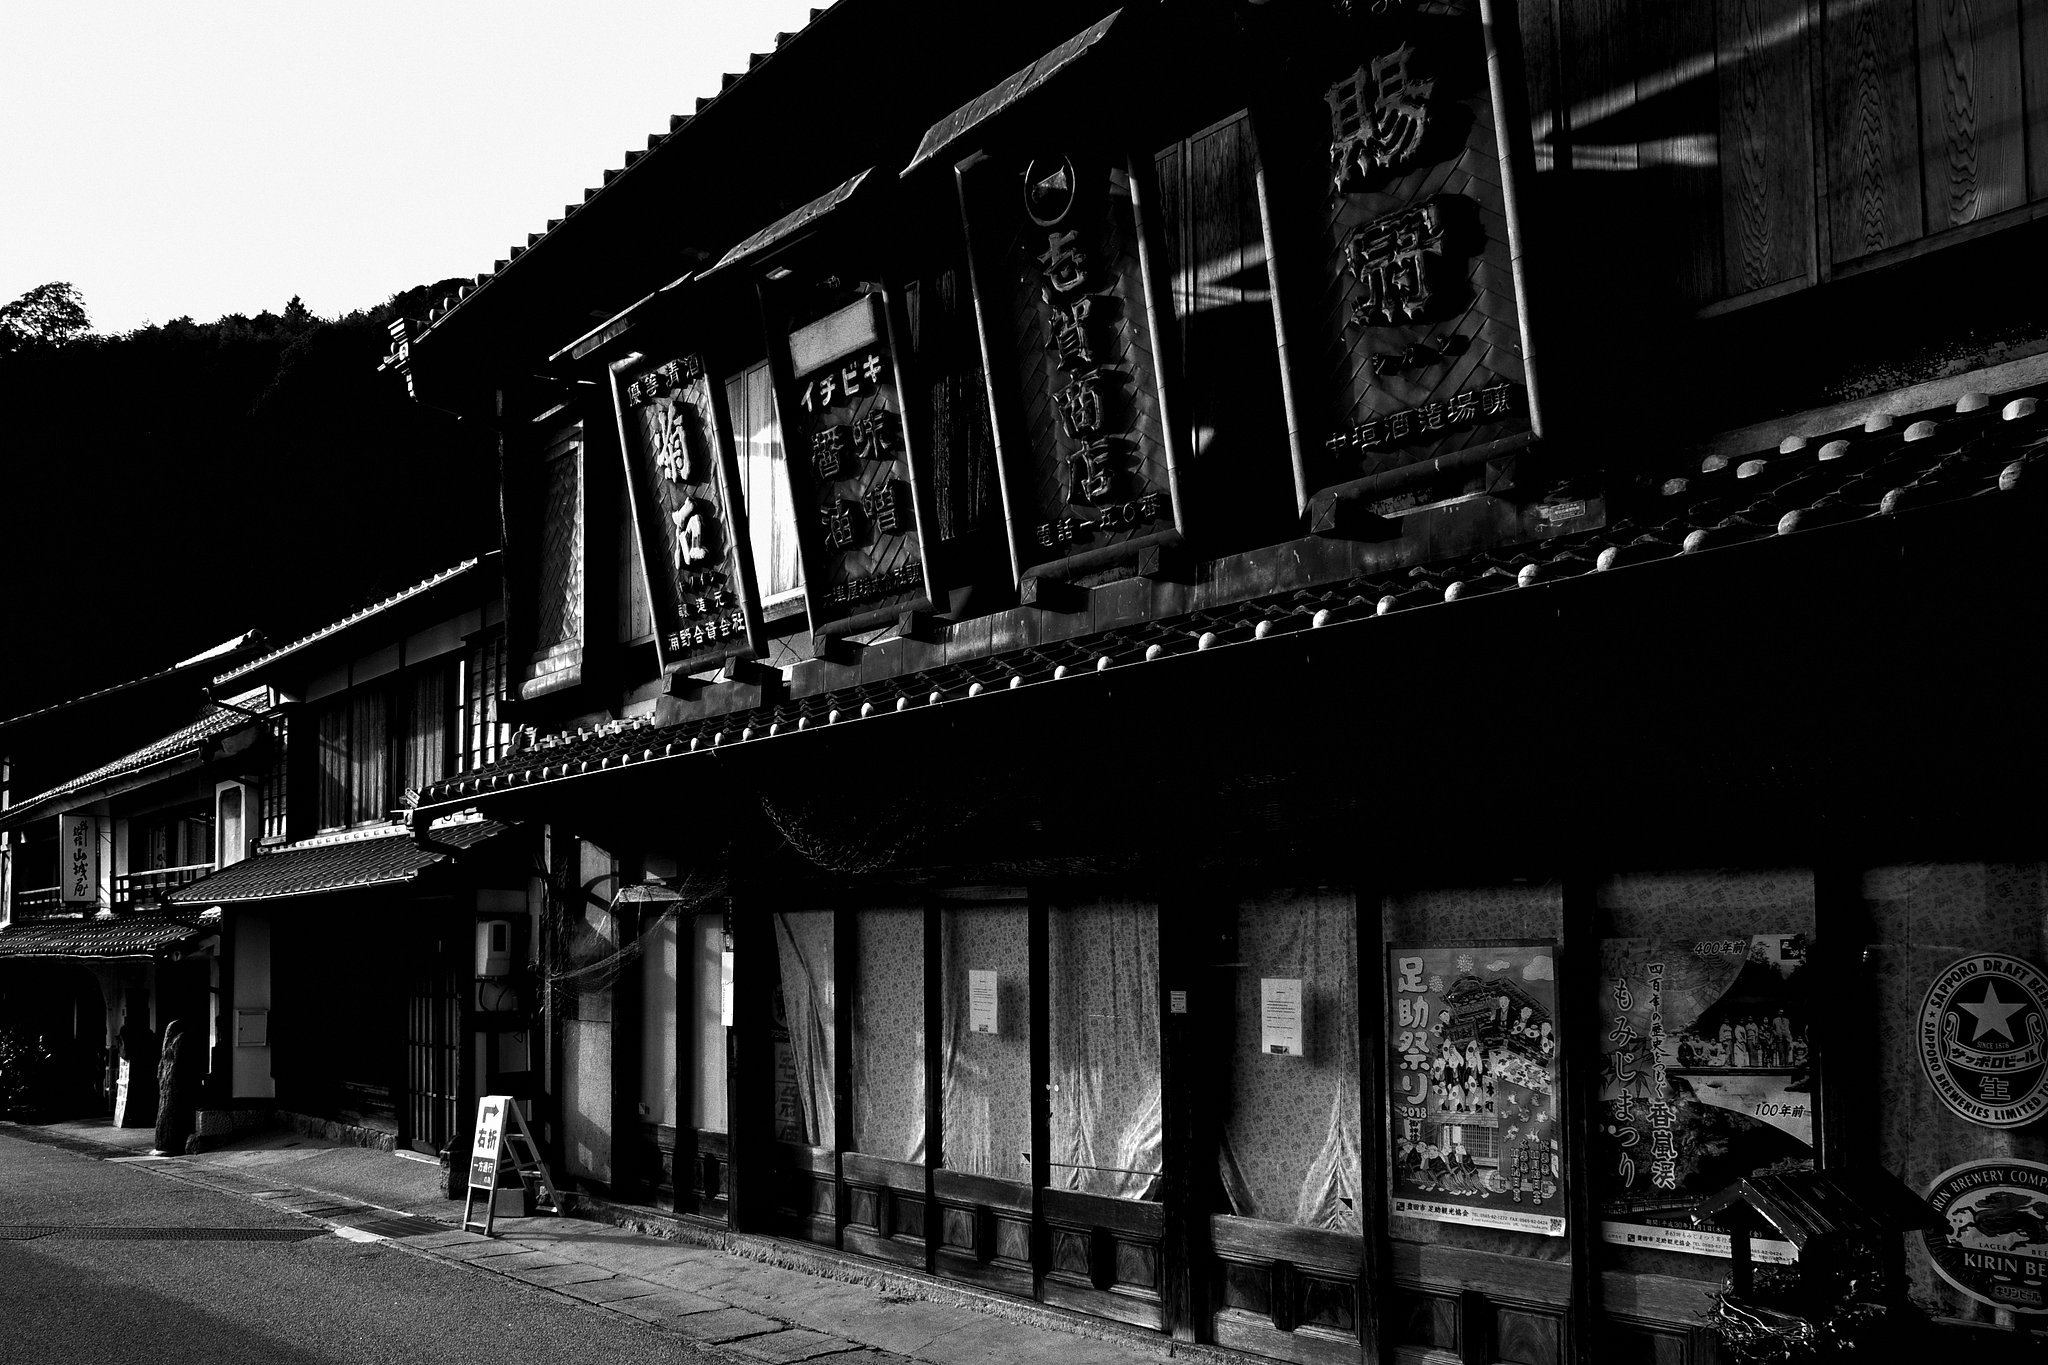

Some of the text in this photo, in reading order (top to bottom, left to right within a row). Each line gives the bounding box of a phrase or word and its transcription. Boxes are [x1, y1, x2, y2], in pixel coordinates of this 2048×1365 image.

[801, 354, 882, 413] イチビキ
[1694, 940, 1746, 955] 400年前
[1931, 962, 1978, 1009] SAPPORO
[1983, 959, 2030, 981] DRAFT
[1398, 956, 1430, 1105] 足助祭り
[1925, 1021, 1941, 1071] SAPPORO
[1935, 1073, 1990, 1120] BREWERIES
[1994, 1096, 2042, 1120] LIMITED
[1951, 1048, 2038, 1069] サッポロビール
[1609, 977, 1640, 1189] もみじまつり
[1979, 1075, 2011, 1101] 生
[1401, 1107, 1427, 1119] 2018
[1754, 1102, 1806, 1118] 100年前
[478, 1128, 497, 1150] 右折
[1647, 1100, 1678, 1190] 香嵐渓
[1933, 1170, 2048, 1212] IRIN BREWERY COMP
[1964, 1253, 2018, 1273] KIRIN
[1996, 1286, 2042, 1303] キリンビール
